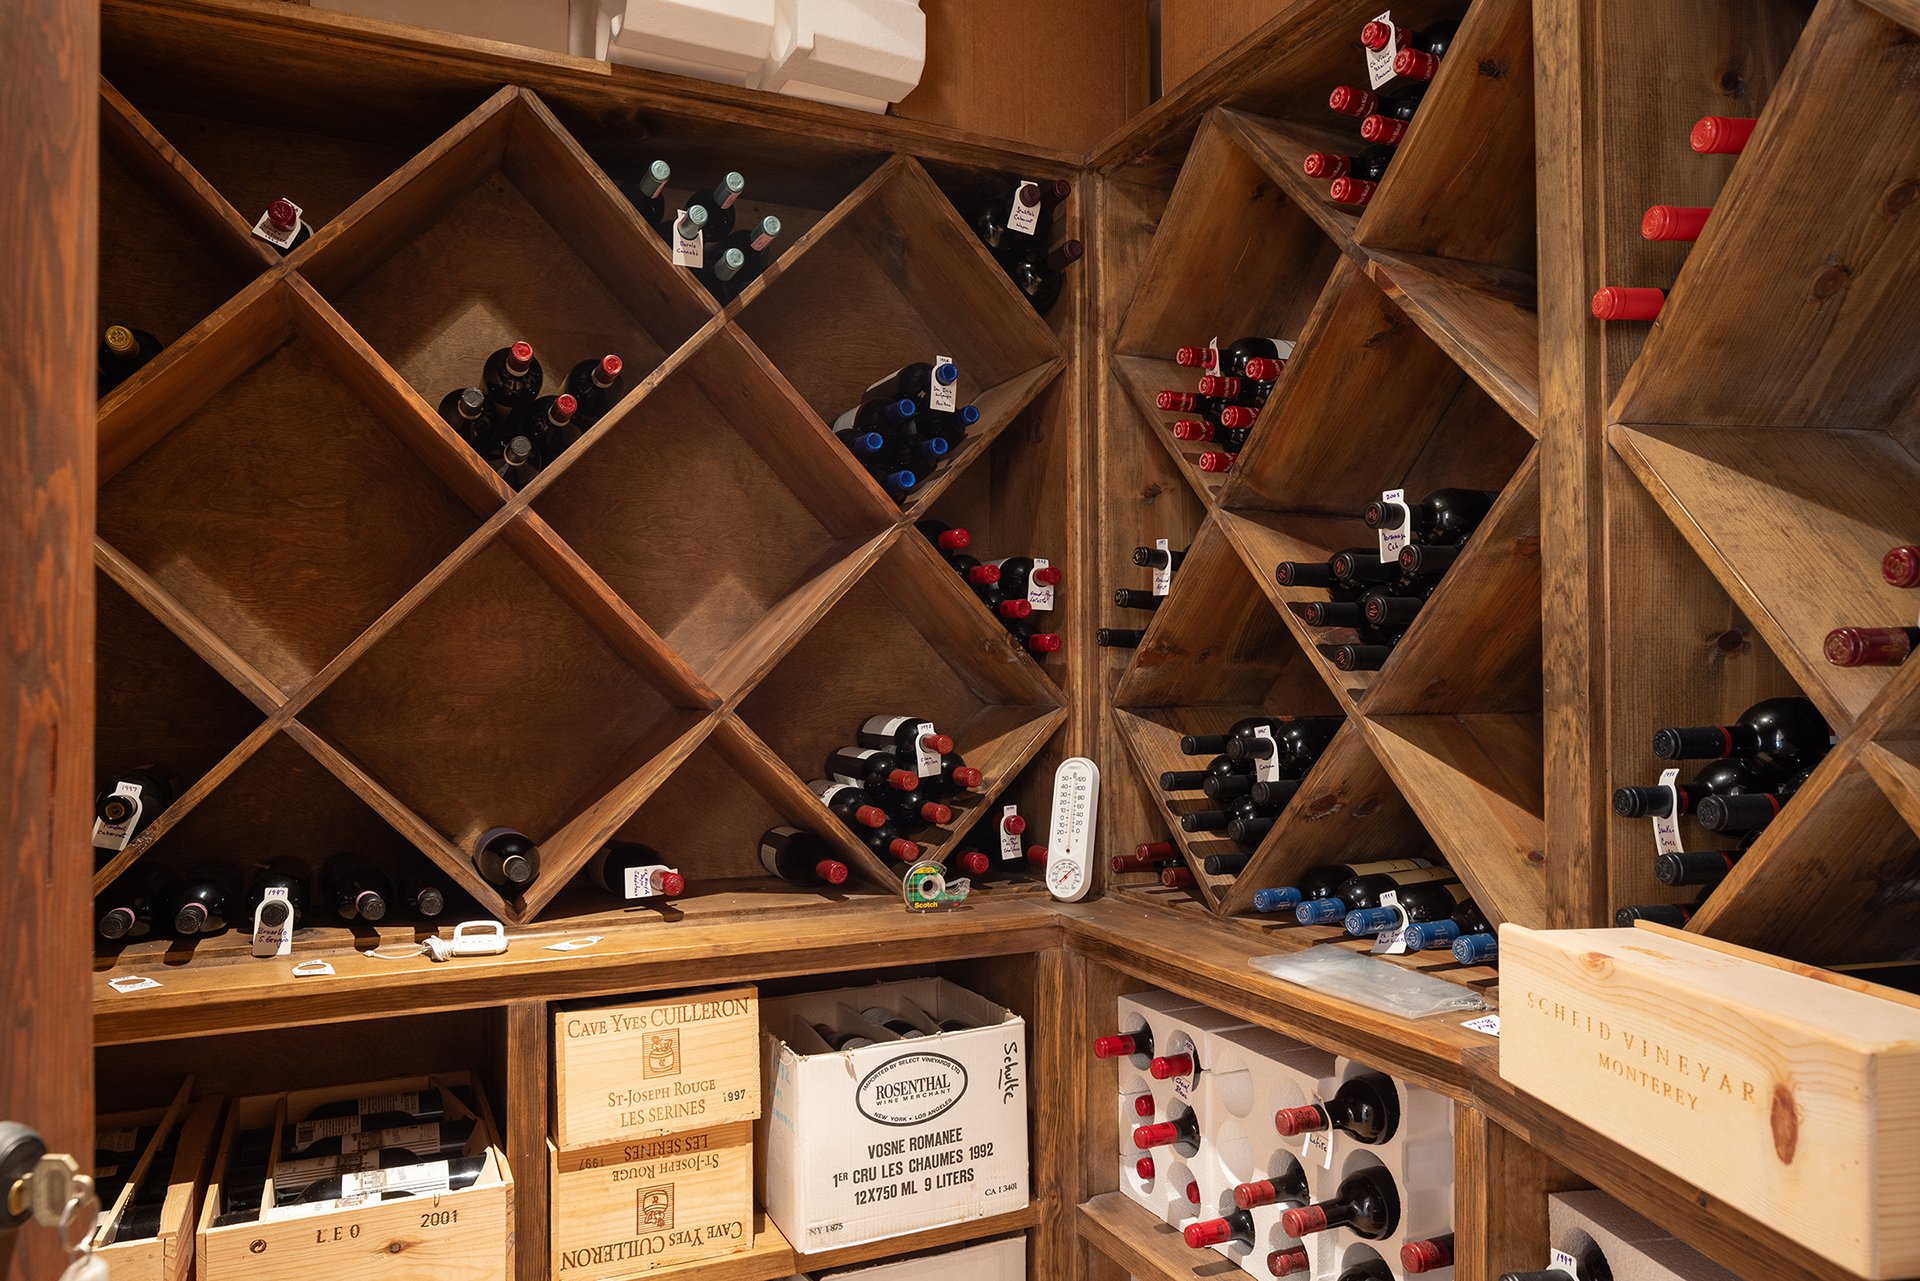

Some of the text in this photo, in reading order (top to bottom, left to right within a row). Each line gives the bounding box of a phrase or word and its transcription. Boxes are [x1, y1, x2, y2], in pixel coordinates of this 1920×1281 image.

[568, 996, 750, 1038] CAVE YVES CUILLERON
[1527, 991, 1611, 1041] SCHEID
[862, 1056, 961, 1091] IMPORTED BY SELECT VINEYARDS LTD
[876, 1074, 951, 1101] ROSENTHAL
[1598, 1052, 1698, 1111] MONTEREY
[608, 1079, 716, 1108] ST-JOSEPH ROUGE
[874, 1112, 888, 1120] NEW
[914, 1112, 927, 1120] LOS
[928, 1098, 953, 1116] ANGELES
[876, 1088, 951, 1106] WINE MERCHANT
[620, 1100, 706, 1128] LES SERINES
[624, 1134, 708, 1162] LES SERINES
[868, 1127, 963, 1160] VOSNE ROMANEE
[612, 1165, 655, 1182] ROUGE
[853, 1168, 877, 1184] CRU
[882, 1161, 904, 1179] LES
[908, 1148, 964, 1174] CHAUMES
[968, 1142, 994, 1161] 1992
[854, 1168, 975, 1206] 12X750 ML 9 LITERS
[420, 1210, 459, 1228] 2001
[560, 1221, 743, 1272] CAVE YVES CUILLERON
